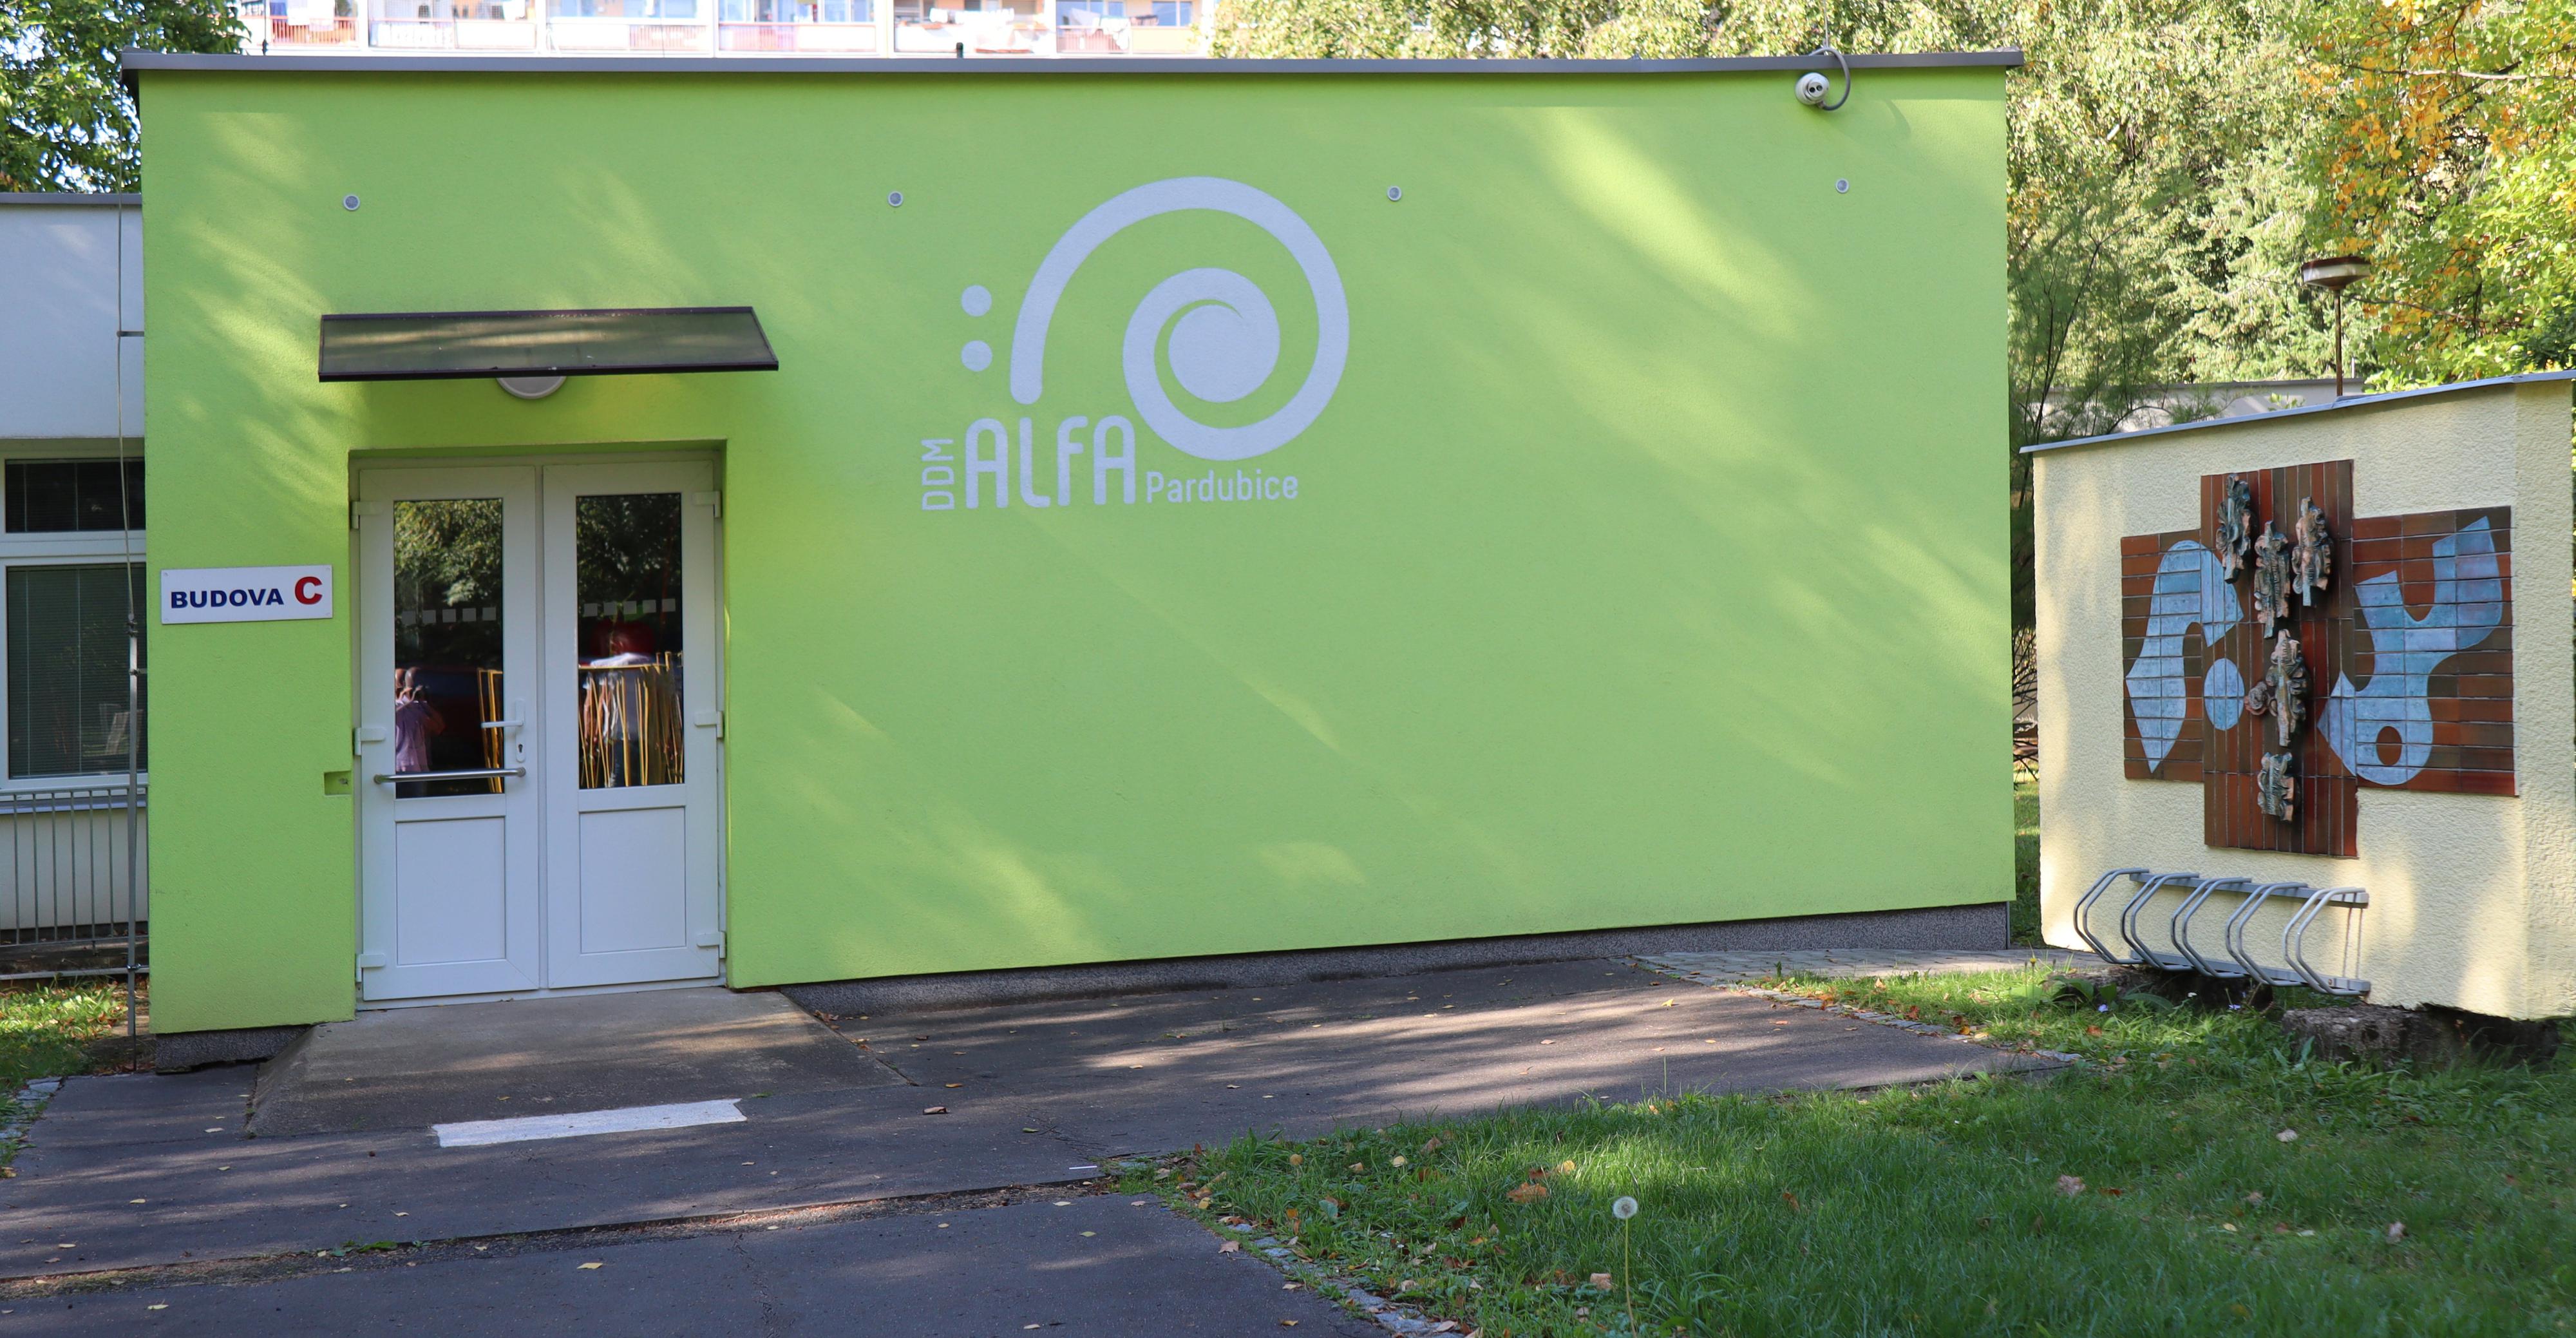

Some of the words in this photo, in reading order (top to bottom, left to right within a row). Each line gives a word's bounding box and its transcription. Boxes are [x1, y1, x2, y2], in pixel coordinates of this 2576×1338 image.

[921, 439, 955, 511] DDM
[965, 415, 1136, 509] ALFA
[1146, 469, 1299, 504] Pardubice
[171, 588, 284, 609] BUDOVA
[294, 576, 323, 605] C
